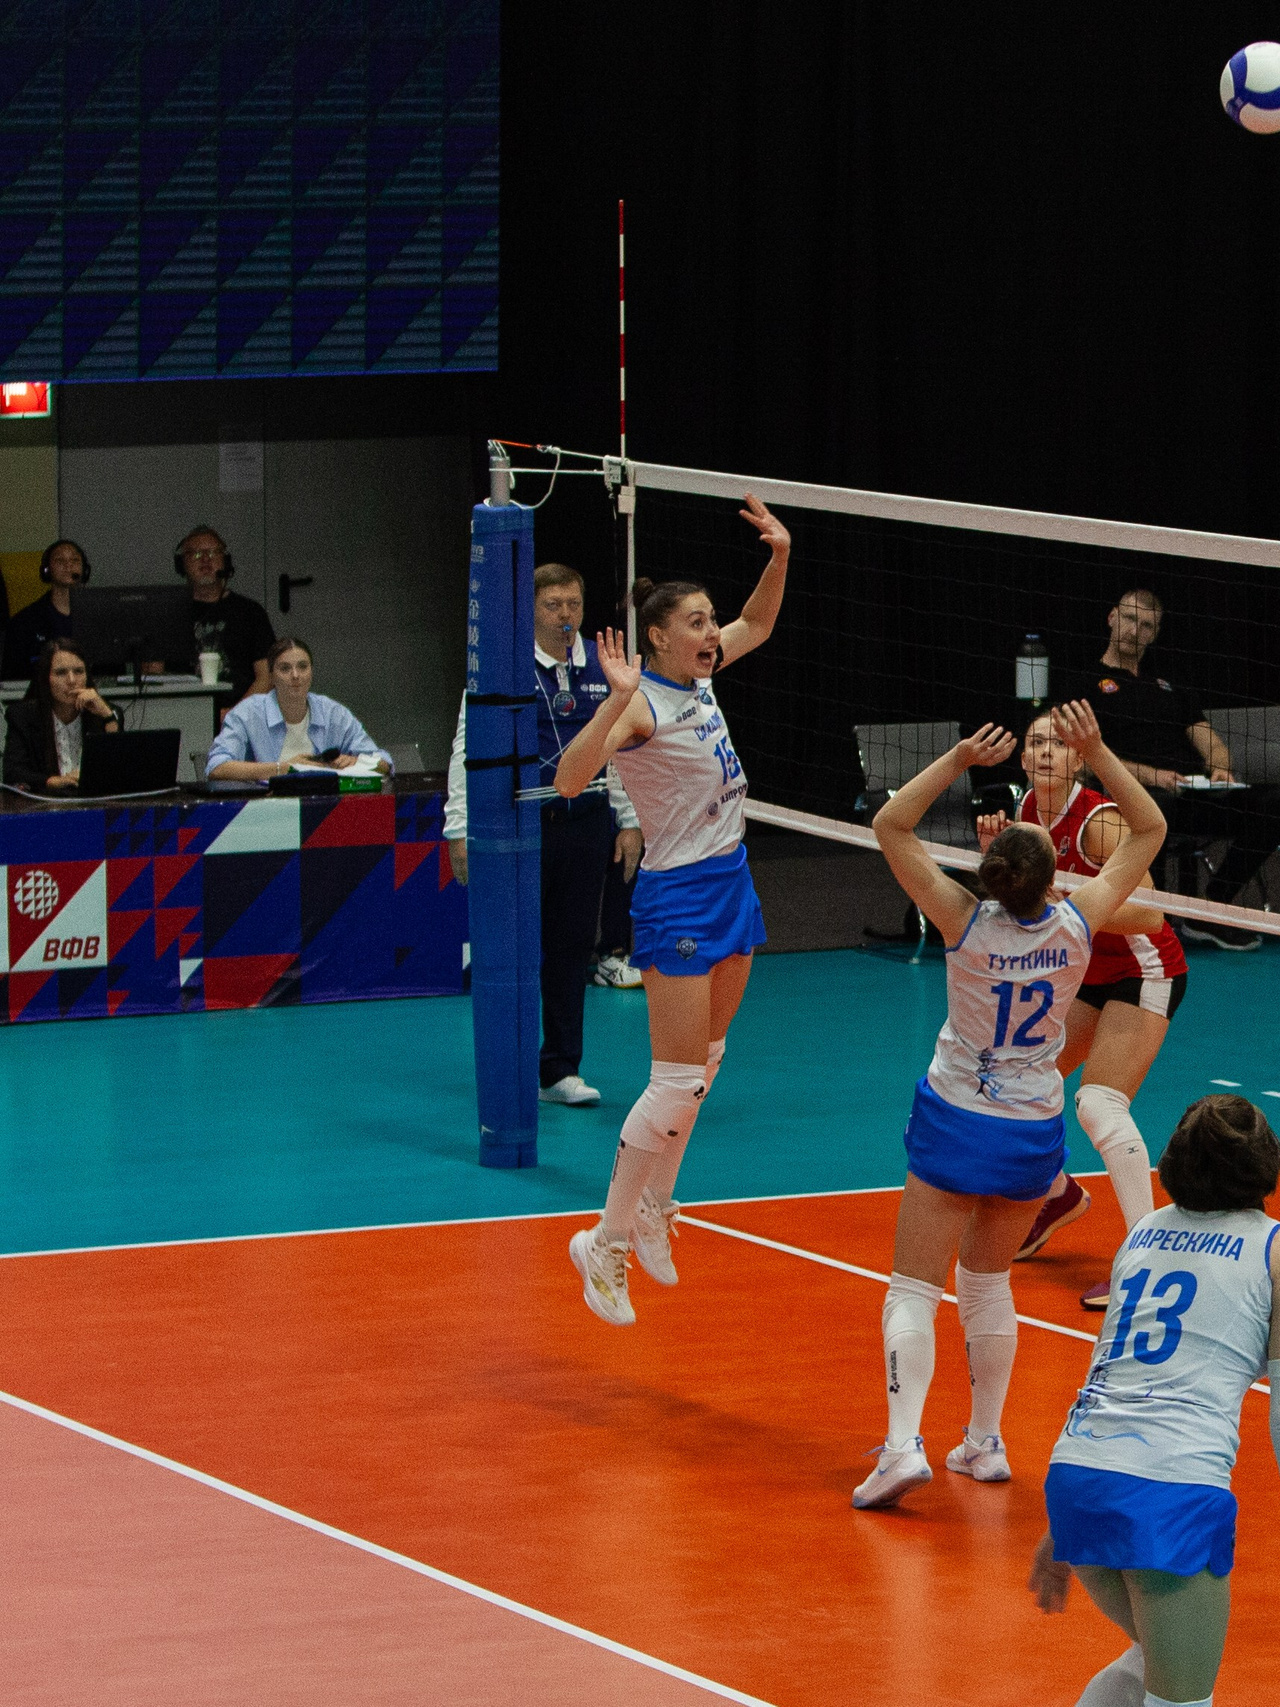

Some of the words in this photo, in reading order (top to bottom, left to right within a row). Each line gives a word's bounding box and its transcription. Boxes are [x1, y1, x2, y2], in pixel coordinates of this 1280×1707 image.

[42, 935, 101, 962] ВФВ
[988, 948, 1069, 970] ТУРКИНА
[990, 979, 1054, 1049] 12
[1108, 1268, 1198, 1365] 13
